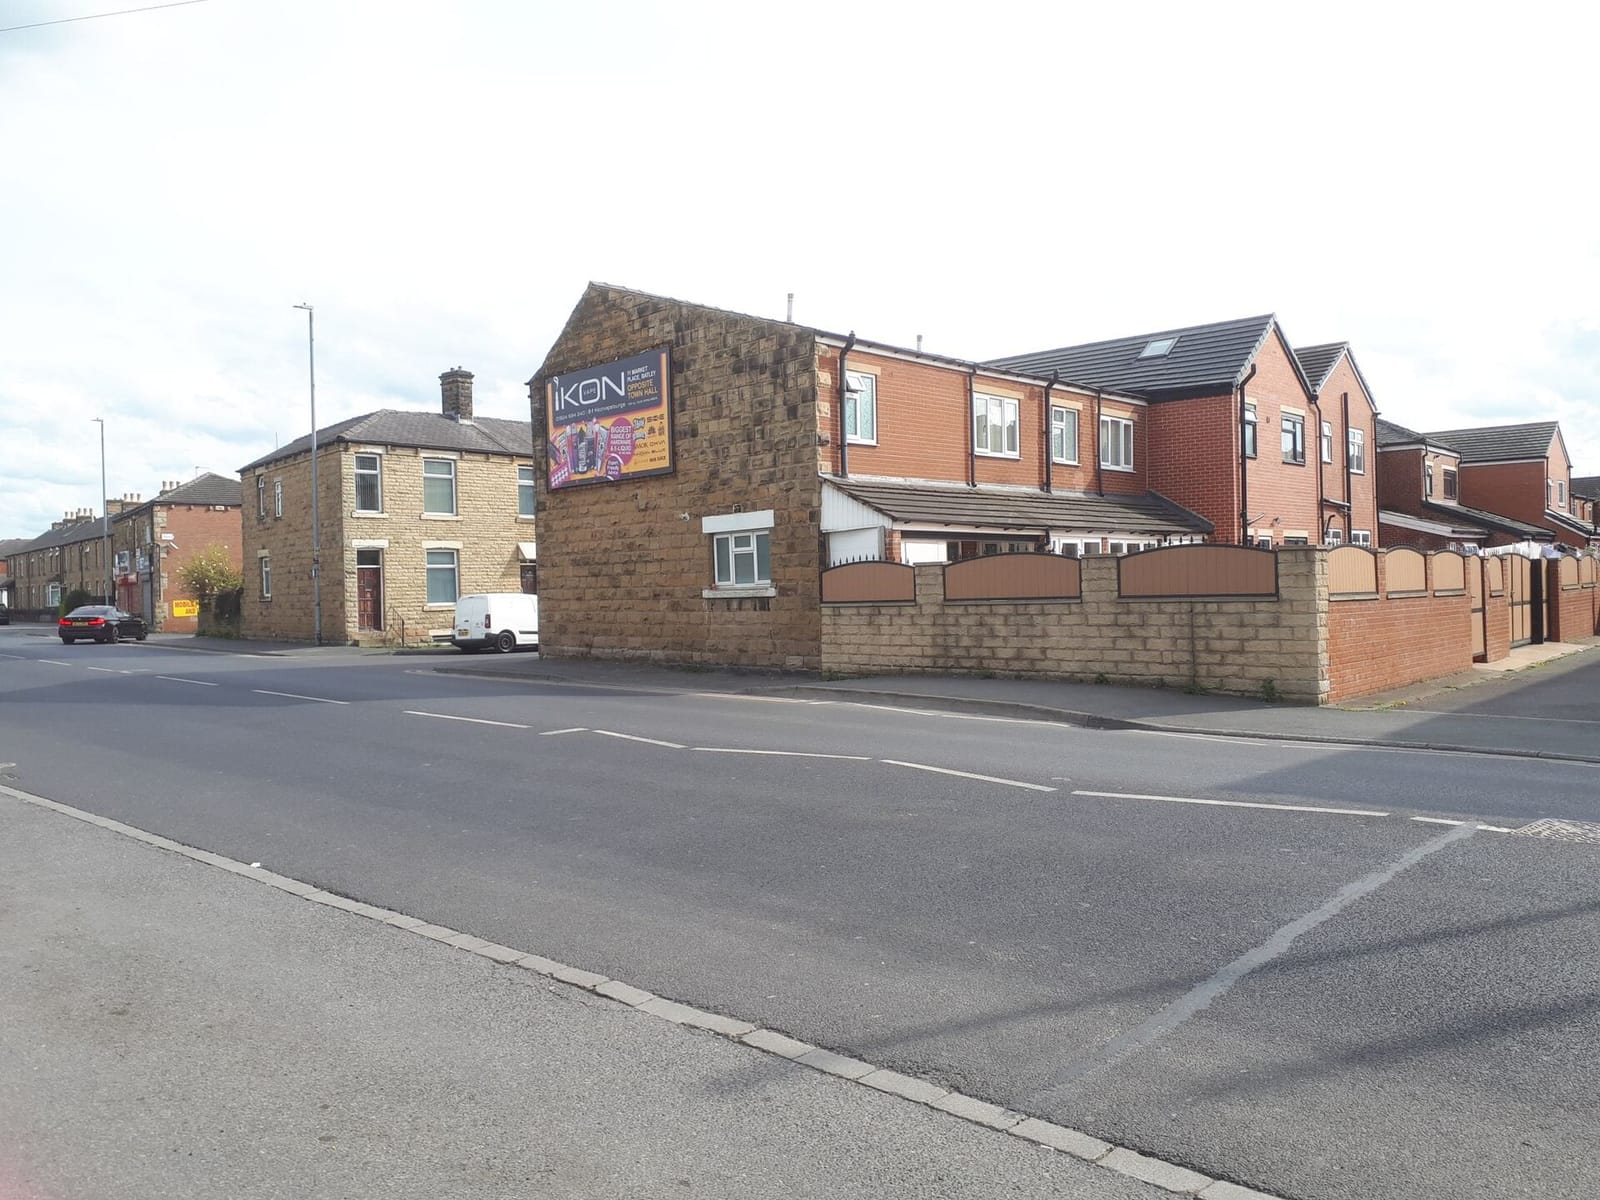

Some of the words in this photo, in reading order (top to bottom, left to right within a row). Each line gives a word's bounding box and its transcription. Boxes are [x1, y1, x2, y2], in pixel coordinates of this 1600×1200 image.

[632, 365, 648, 375] MARKET
[641, 370, 656, 379] BATLEY
[627, 379, 653, 391] OPPOSITE
[627, 390, 643, 399] TOWN
[644, 387, 658, 396] HALL
[610, 425, 631, 433] BIGGEST
